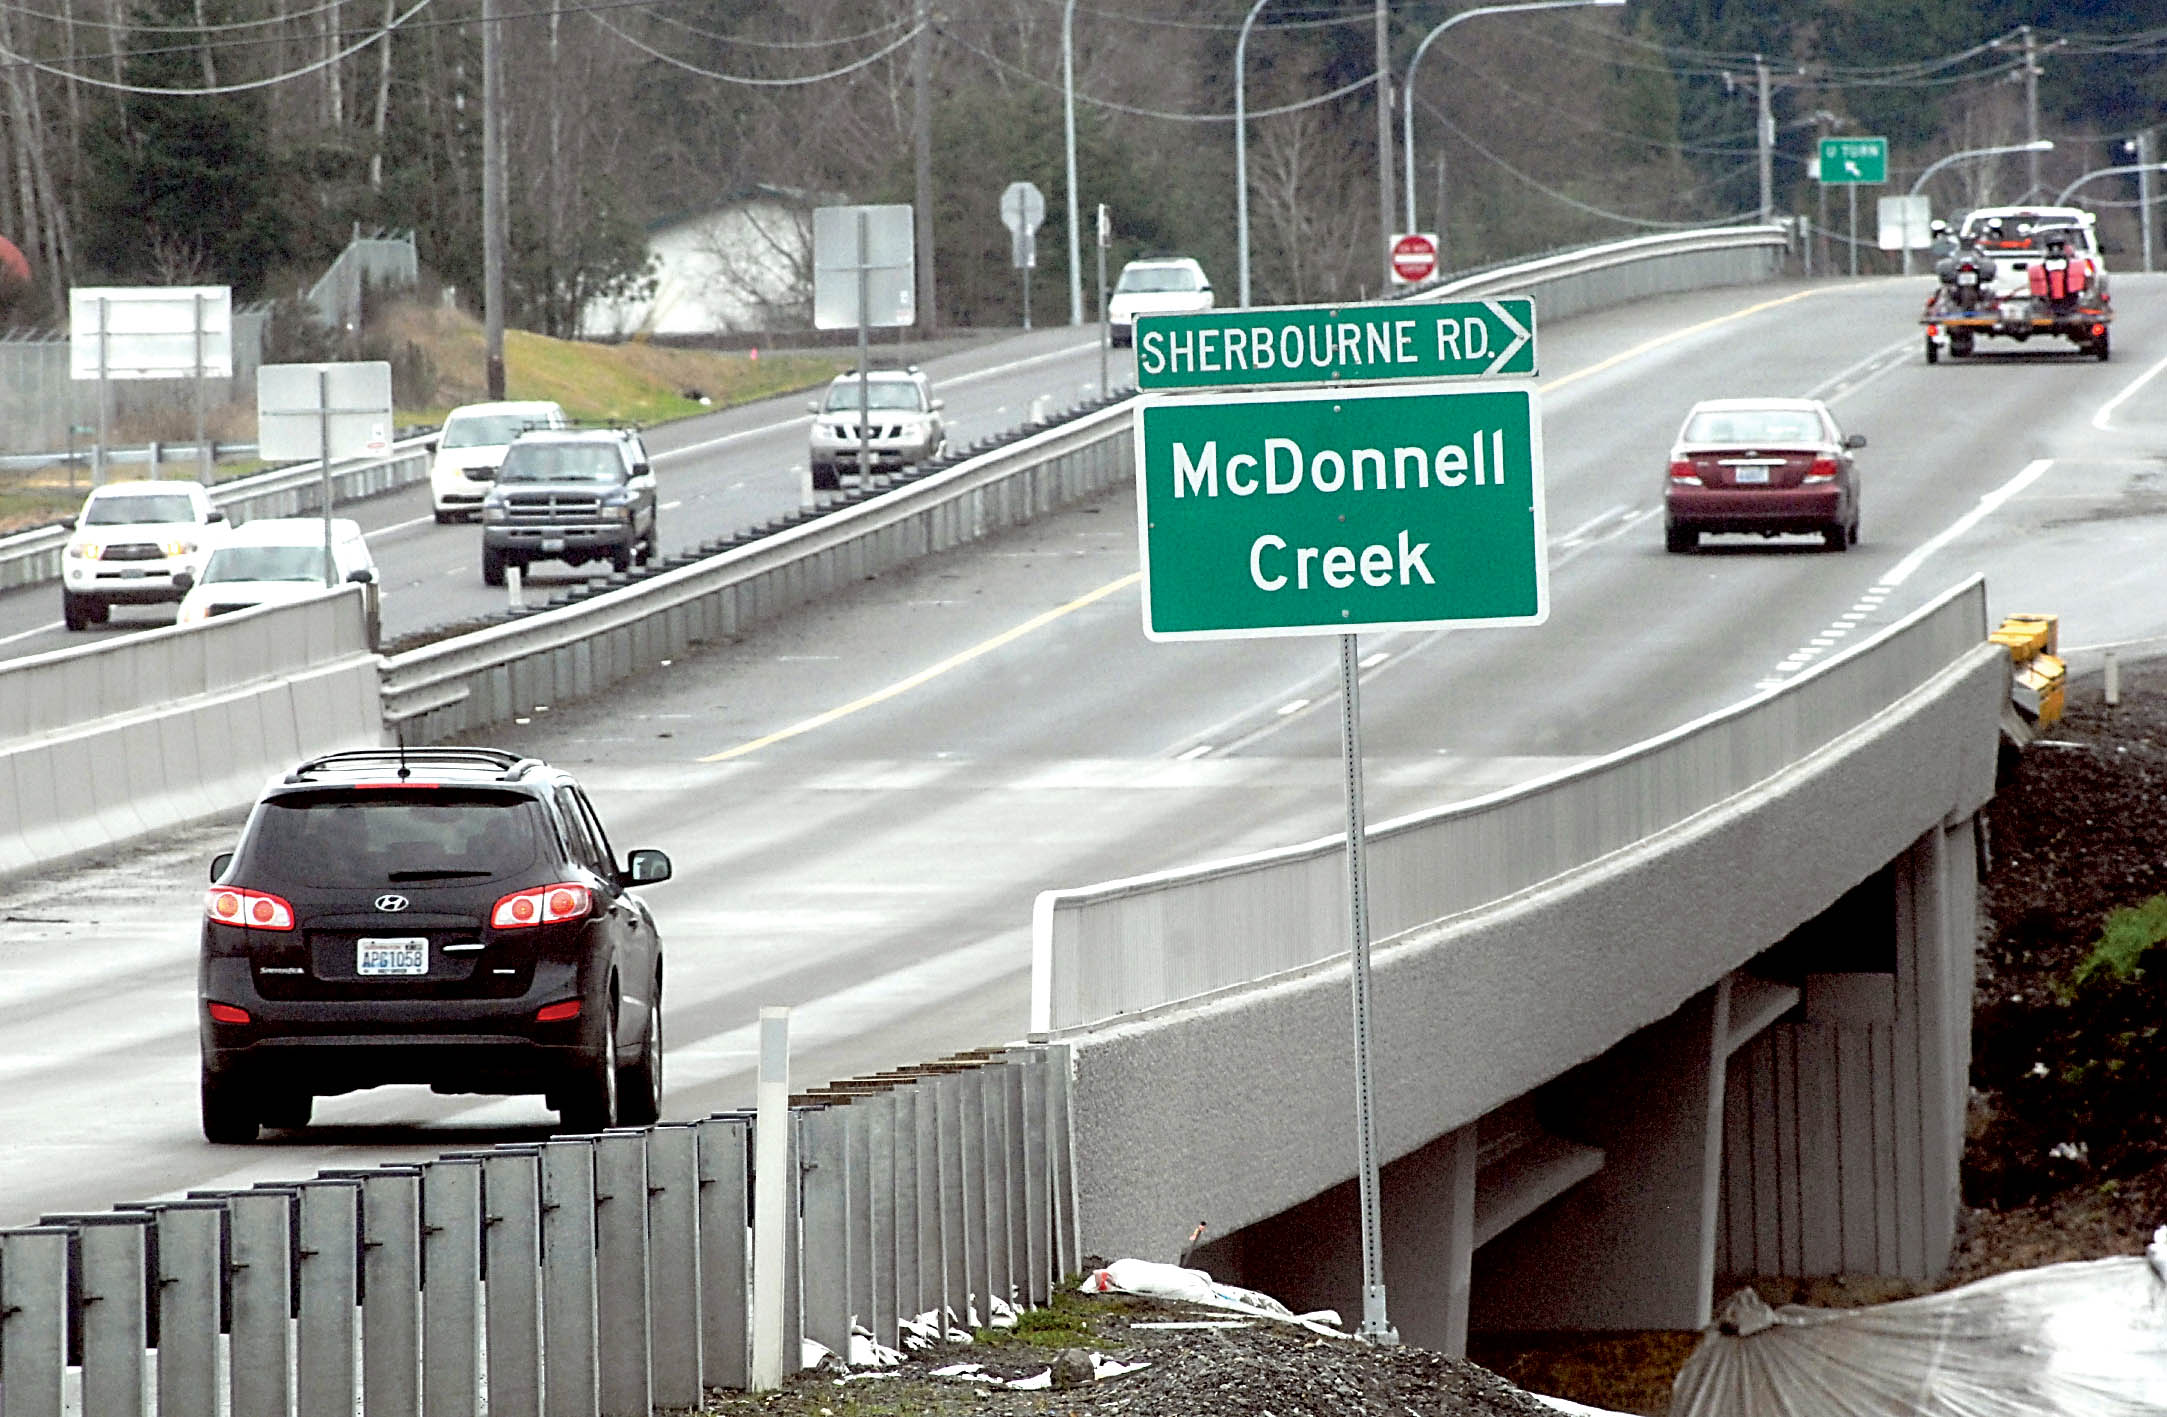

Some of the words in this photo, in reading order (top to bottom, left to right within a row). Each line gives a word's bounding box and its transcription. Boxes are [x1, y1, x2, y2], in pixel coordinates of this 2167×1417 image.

[1142, 319, 1418, 374] SHERBOURNE
[1436, 317, 1495, 361] RD.
[1172, 428, 1504, 498] McDonnell
[1250, 529, 1436, 592] Creek
